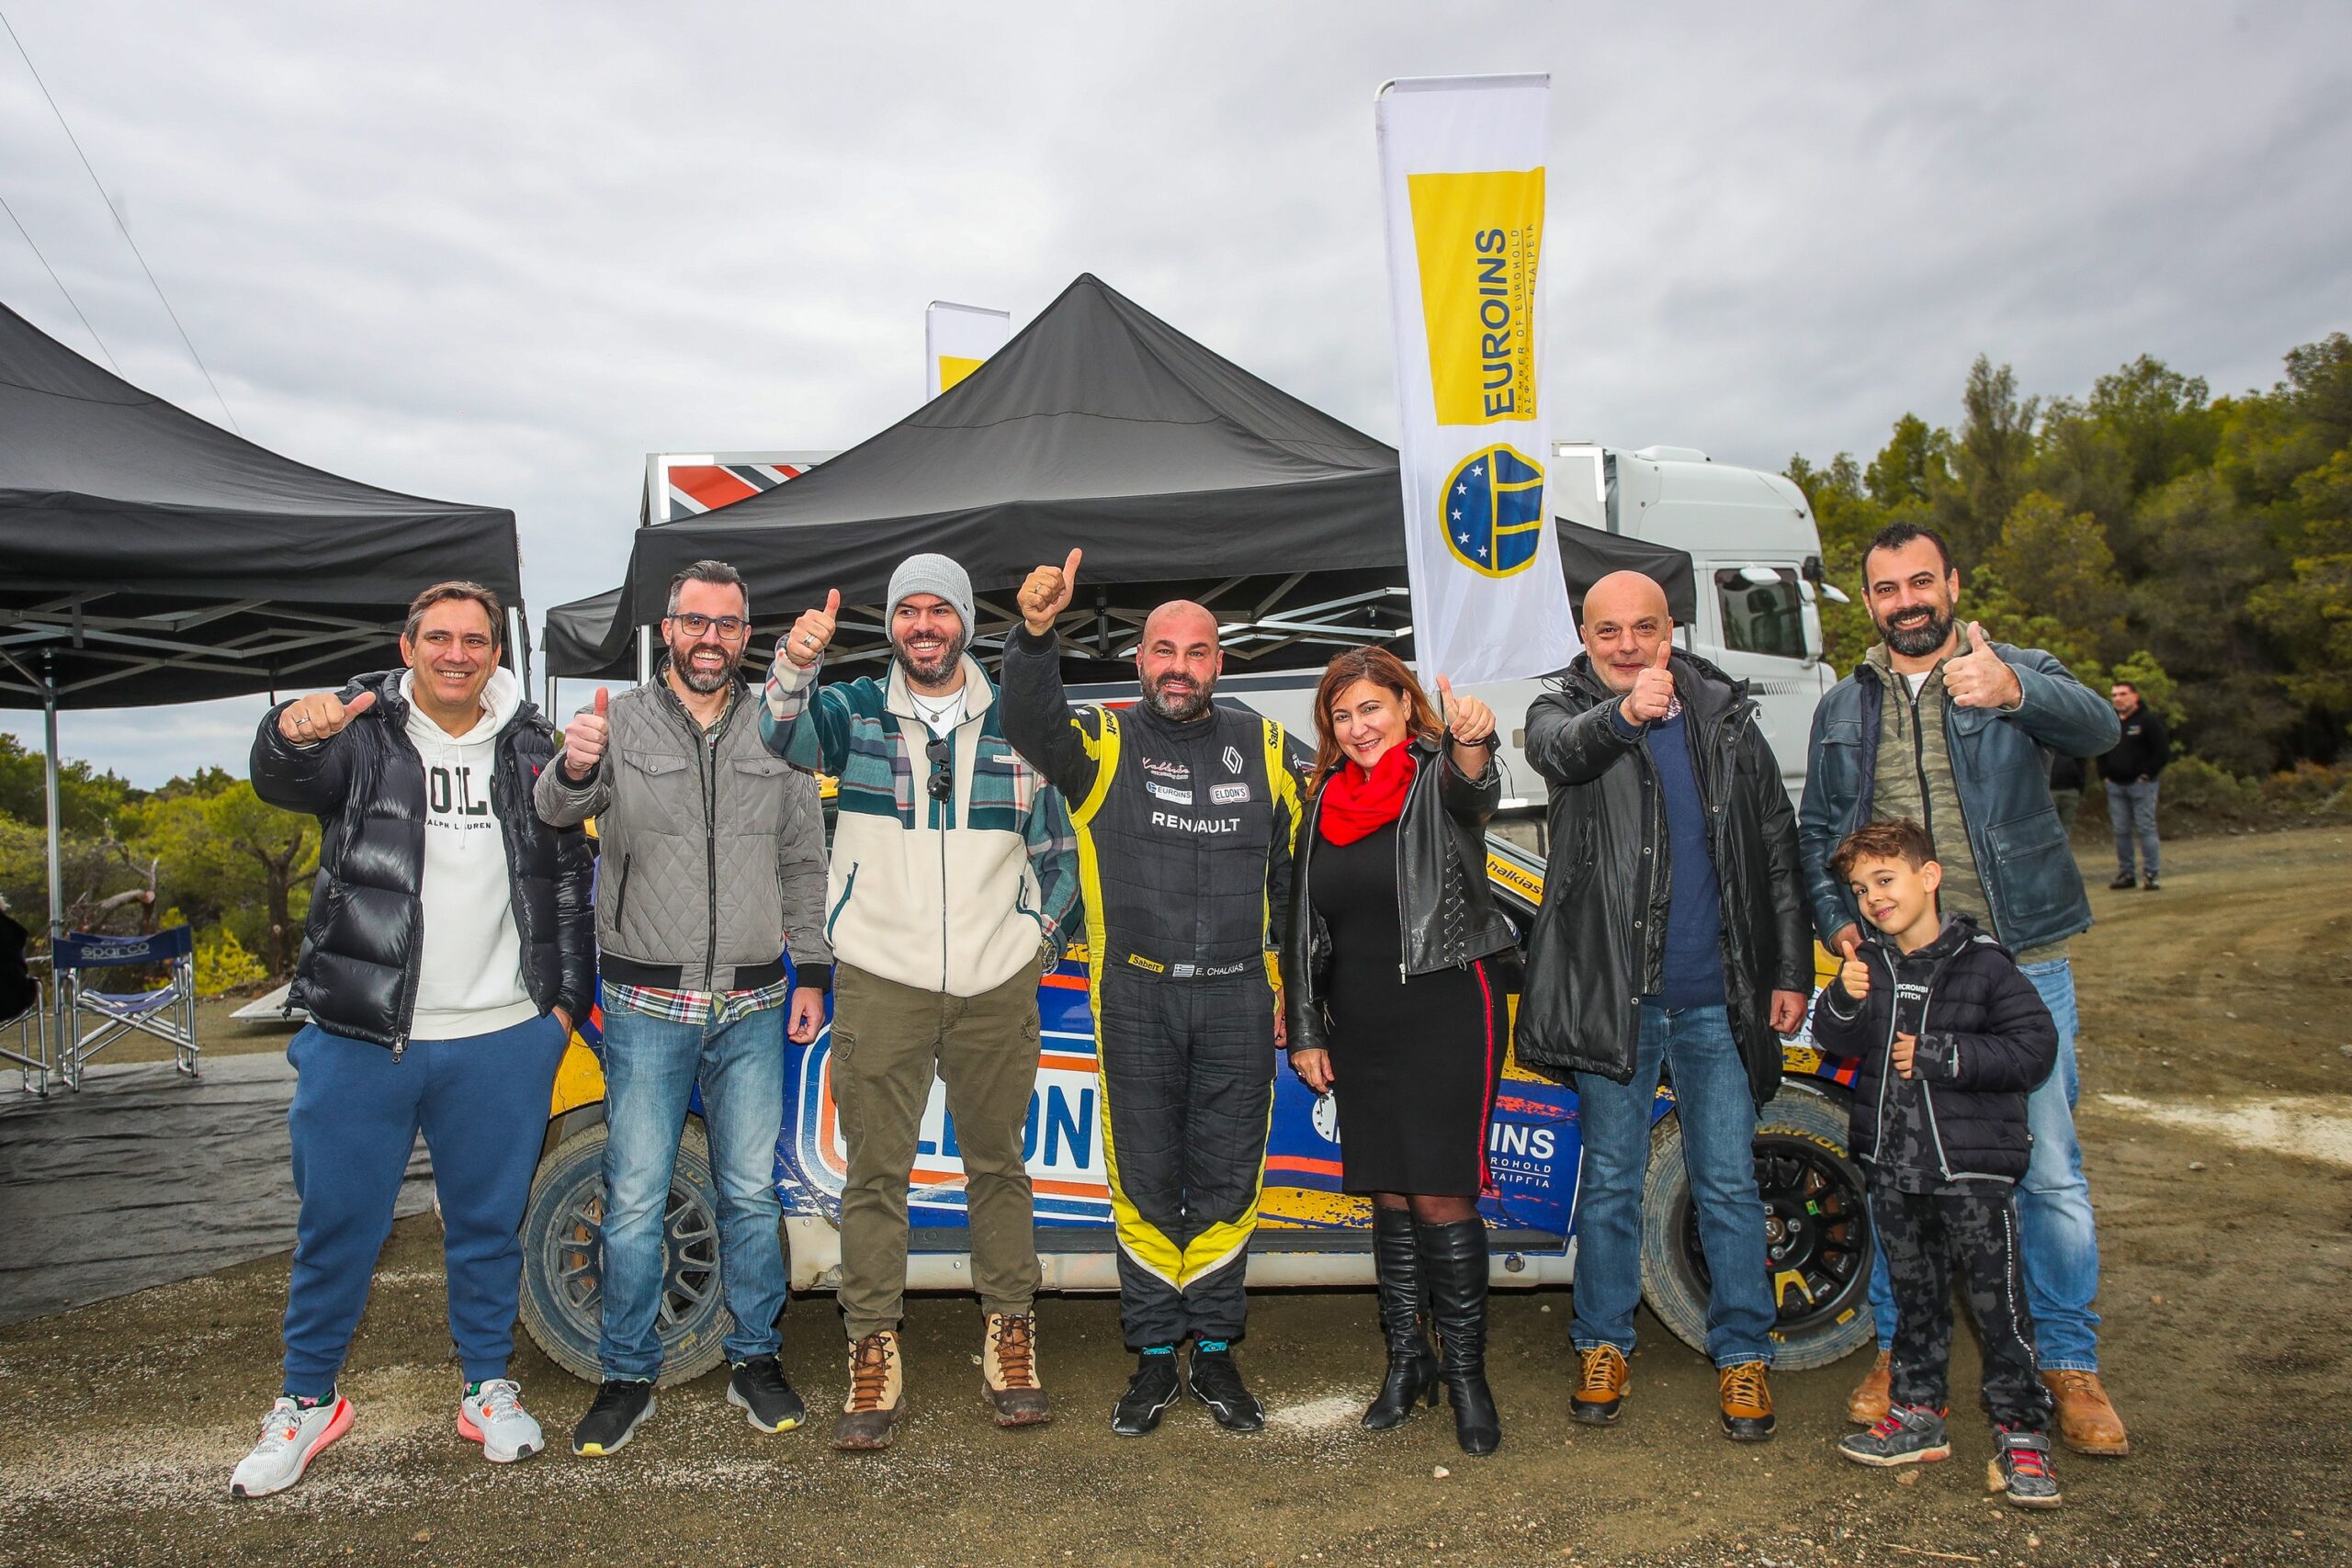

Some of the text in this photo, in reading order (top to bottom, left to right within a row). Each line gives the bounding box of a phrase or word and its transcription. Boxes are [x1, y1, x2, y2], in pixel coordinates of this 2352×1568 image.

[1510, 230, 1522, 310] EUROHOLD
[1476, 229, 1514, 417] EUROINS
[1516, 320, 1524, 337] OF
[1158, 785, 1191, 799] EUROINS
[1216, 788, 1246, 799] ELDON'S
[424, 818, 492, 830] ALPH LUREN
[1152, 811, 1240, 833] RENAULT
[81, 942, 150, 960] sparco
[1206, 963, 1244, 976] CHALKIAS
[1900, 992, 1922, 1001] FITCH
